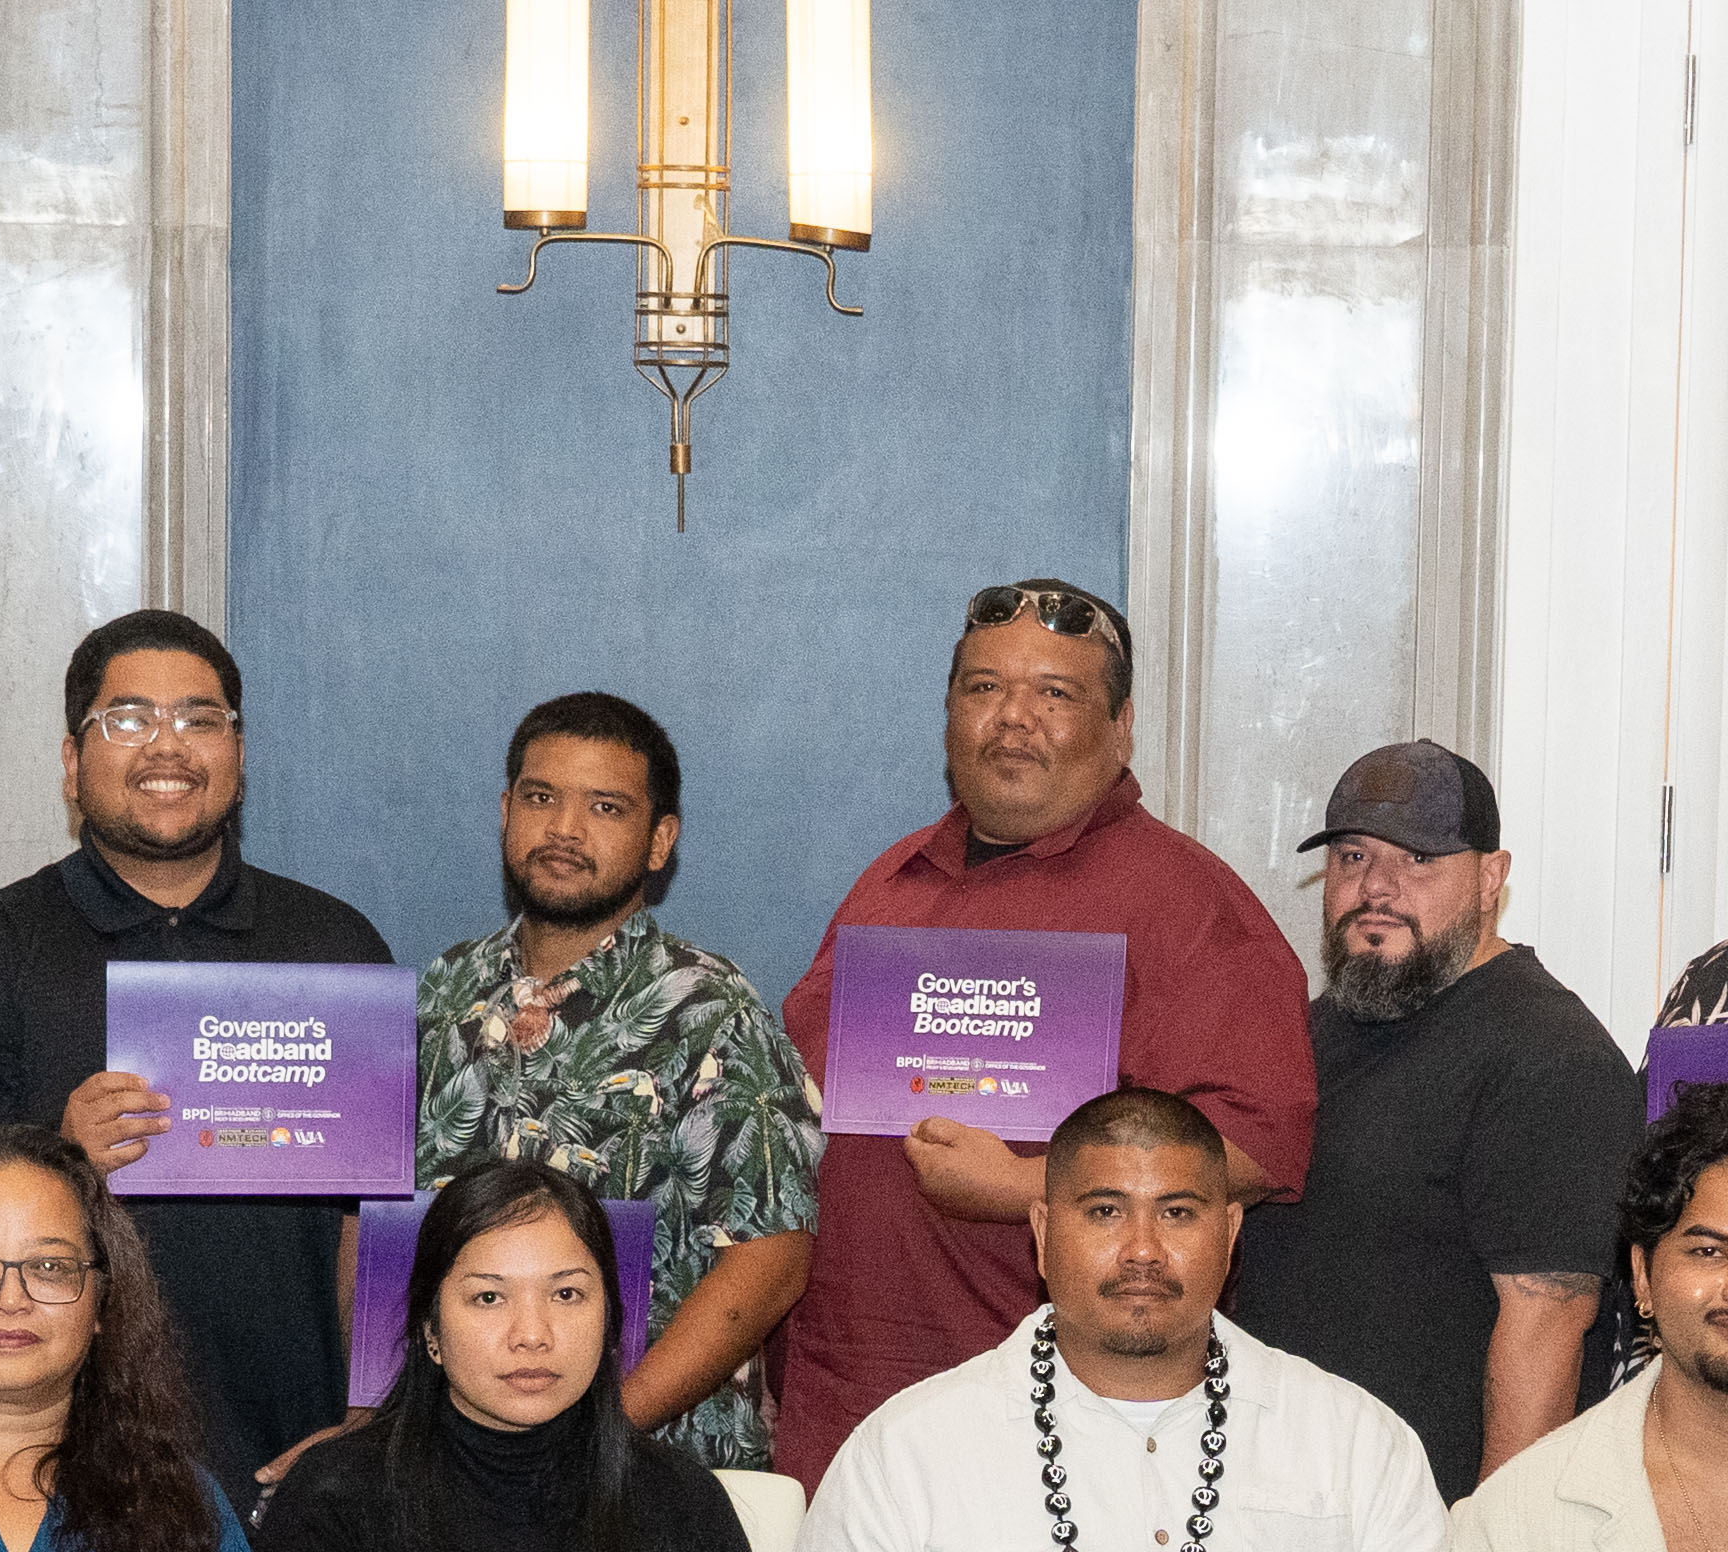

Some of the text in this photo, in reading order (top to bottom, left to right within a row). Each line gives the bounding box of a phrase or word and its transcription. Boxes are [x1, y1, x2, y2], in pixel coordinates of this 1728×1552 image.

[918, 973, 1036, 996] Governor's
[199, 1015, 326, 1038] Governor's
[913, 1013, 1034, 1041] Bootcamp
[198, 1060, 326, 1088] Bootcamp
[896, 1057, 922, 1068] BPD
[182, 1108, 210, 1120] BPD
